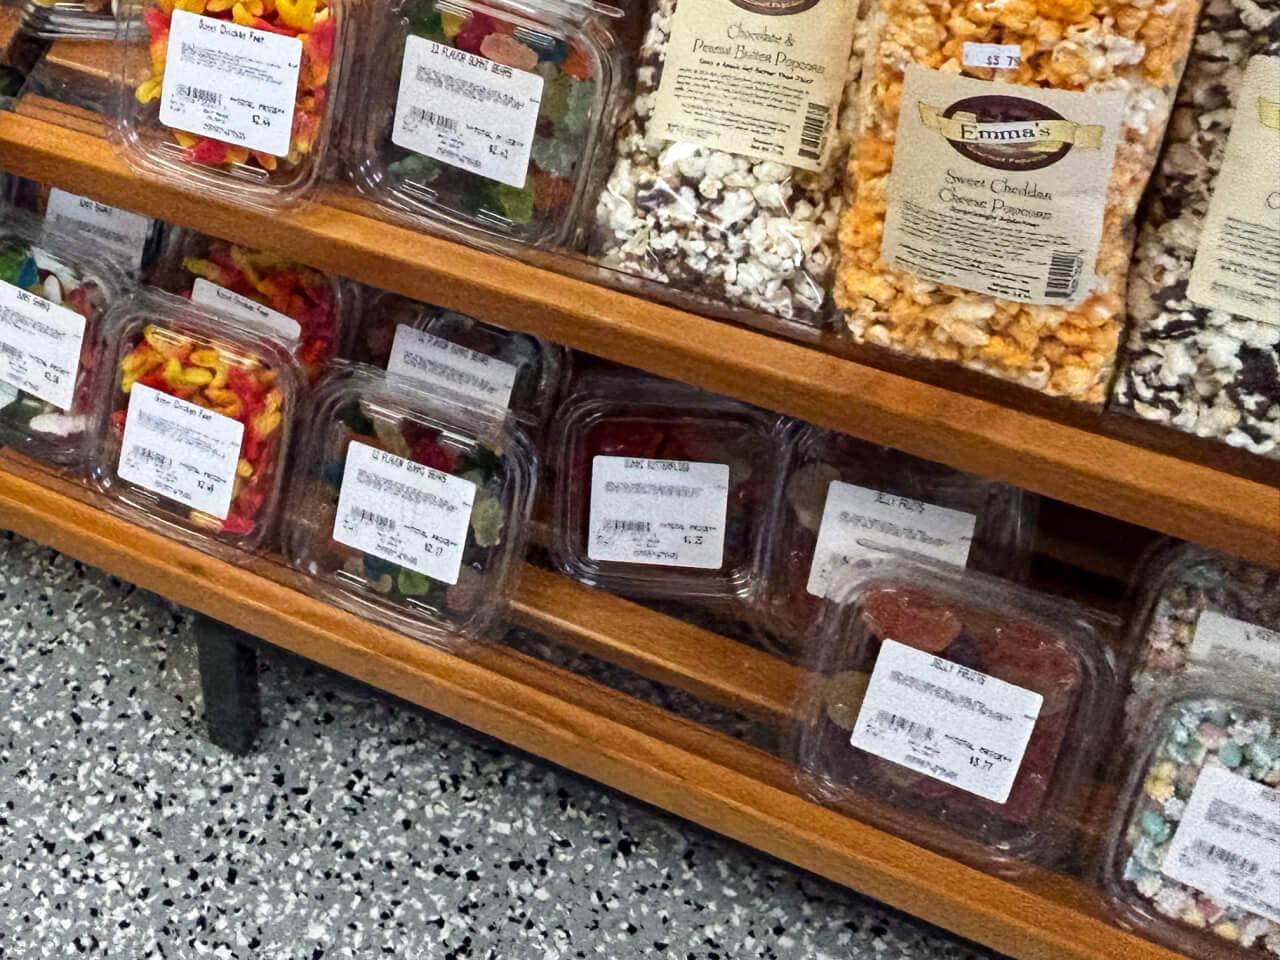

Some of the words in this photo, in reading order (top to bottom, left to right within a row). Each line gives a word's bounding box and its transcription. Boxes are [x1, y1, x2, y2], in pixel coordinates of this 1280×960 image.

[692, 38, 732, 56] Peanut
[734, 43, 773, 65] Butter
[775, 51, 826, 76] Popcorn
[960, 121, 1051, 142] Emma's
[944, 168, 986, 187] Sweet
[989, 178, 1053, 202] Cheddar
[937, 187, 988, 211] Cheese
[991, 198, 1054, 221] Popcorn
